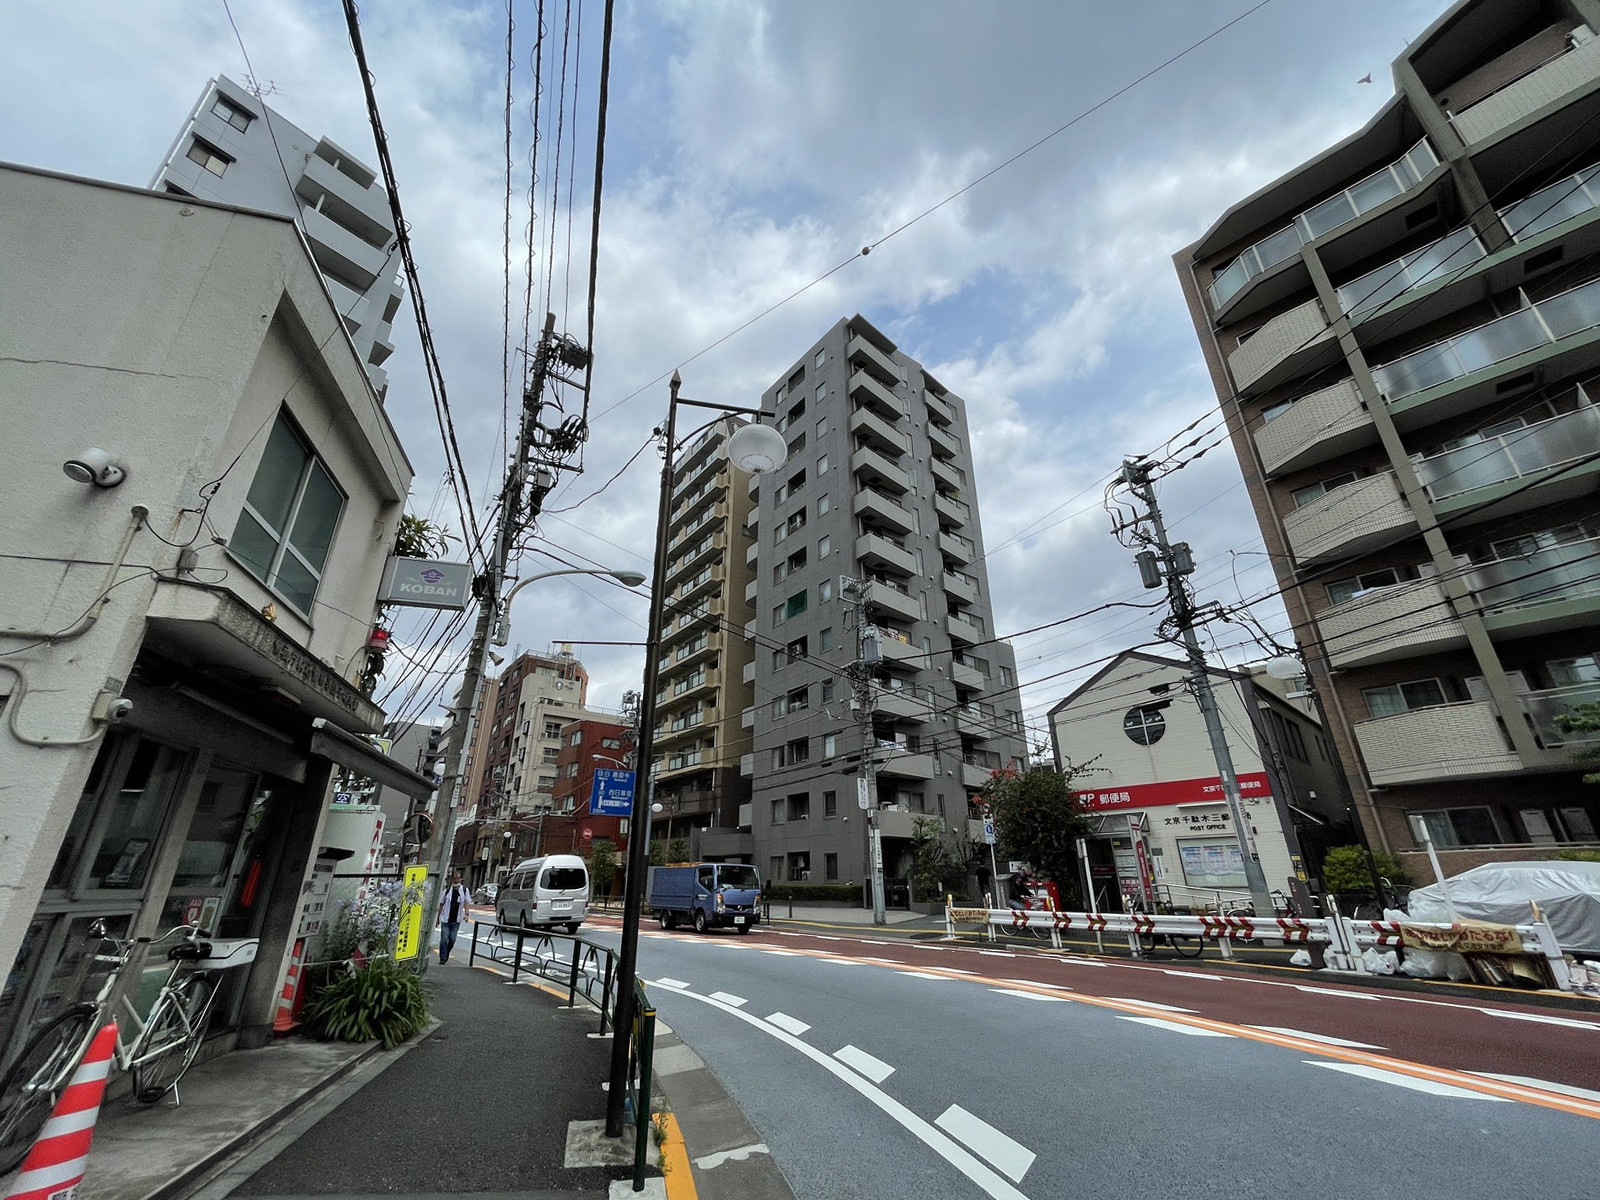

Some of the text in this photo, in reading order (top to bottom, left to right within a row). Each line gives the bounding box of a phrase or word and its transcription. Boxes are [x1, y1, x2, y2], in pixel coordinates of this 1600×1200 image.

[400, 583, 457, 597] KOBAN
[1203, 781, 1262, 793] 文京千郵便局
[1099, 792, 1131, 804] 郵便局
[1164, 812, 1252, 826] 文京千駄木三郵
